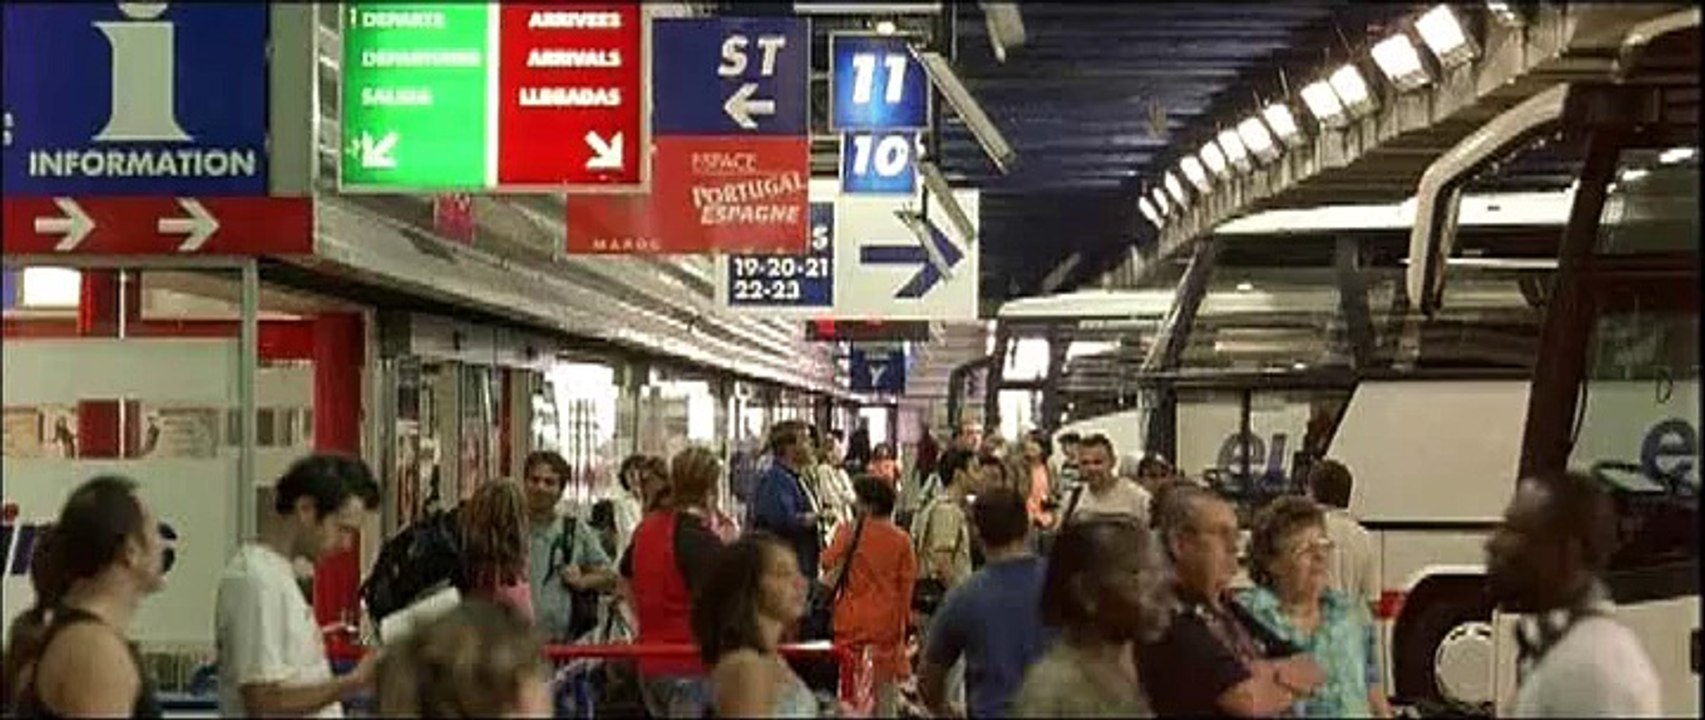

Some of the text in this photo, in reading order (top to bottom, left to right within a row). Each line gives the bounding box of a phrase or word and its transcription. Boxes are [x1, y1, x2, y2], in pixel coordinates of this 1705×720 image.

[526, 48, 622, 68] ARRIVALS
[852, 53, 906, 104] 11
[518, 86, 622, 107] LLEGADAS
[29, 150, 256, 177] INFORMATION
[853, 134, 909, 177] 10
[692, 169, 806, 210] PORTUGAL
[700, 203, 801, 225] ESPAGNE
[592, 237, 661, 251] MAROC
